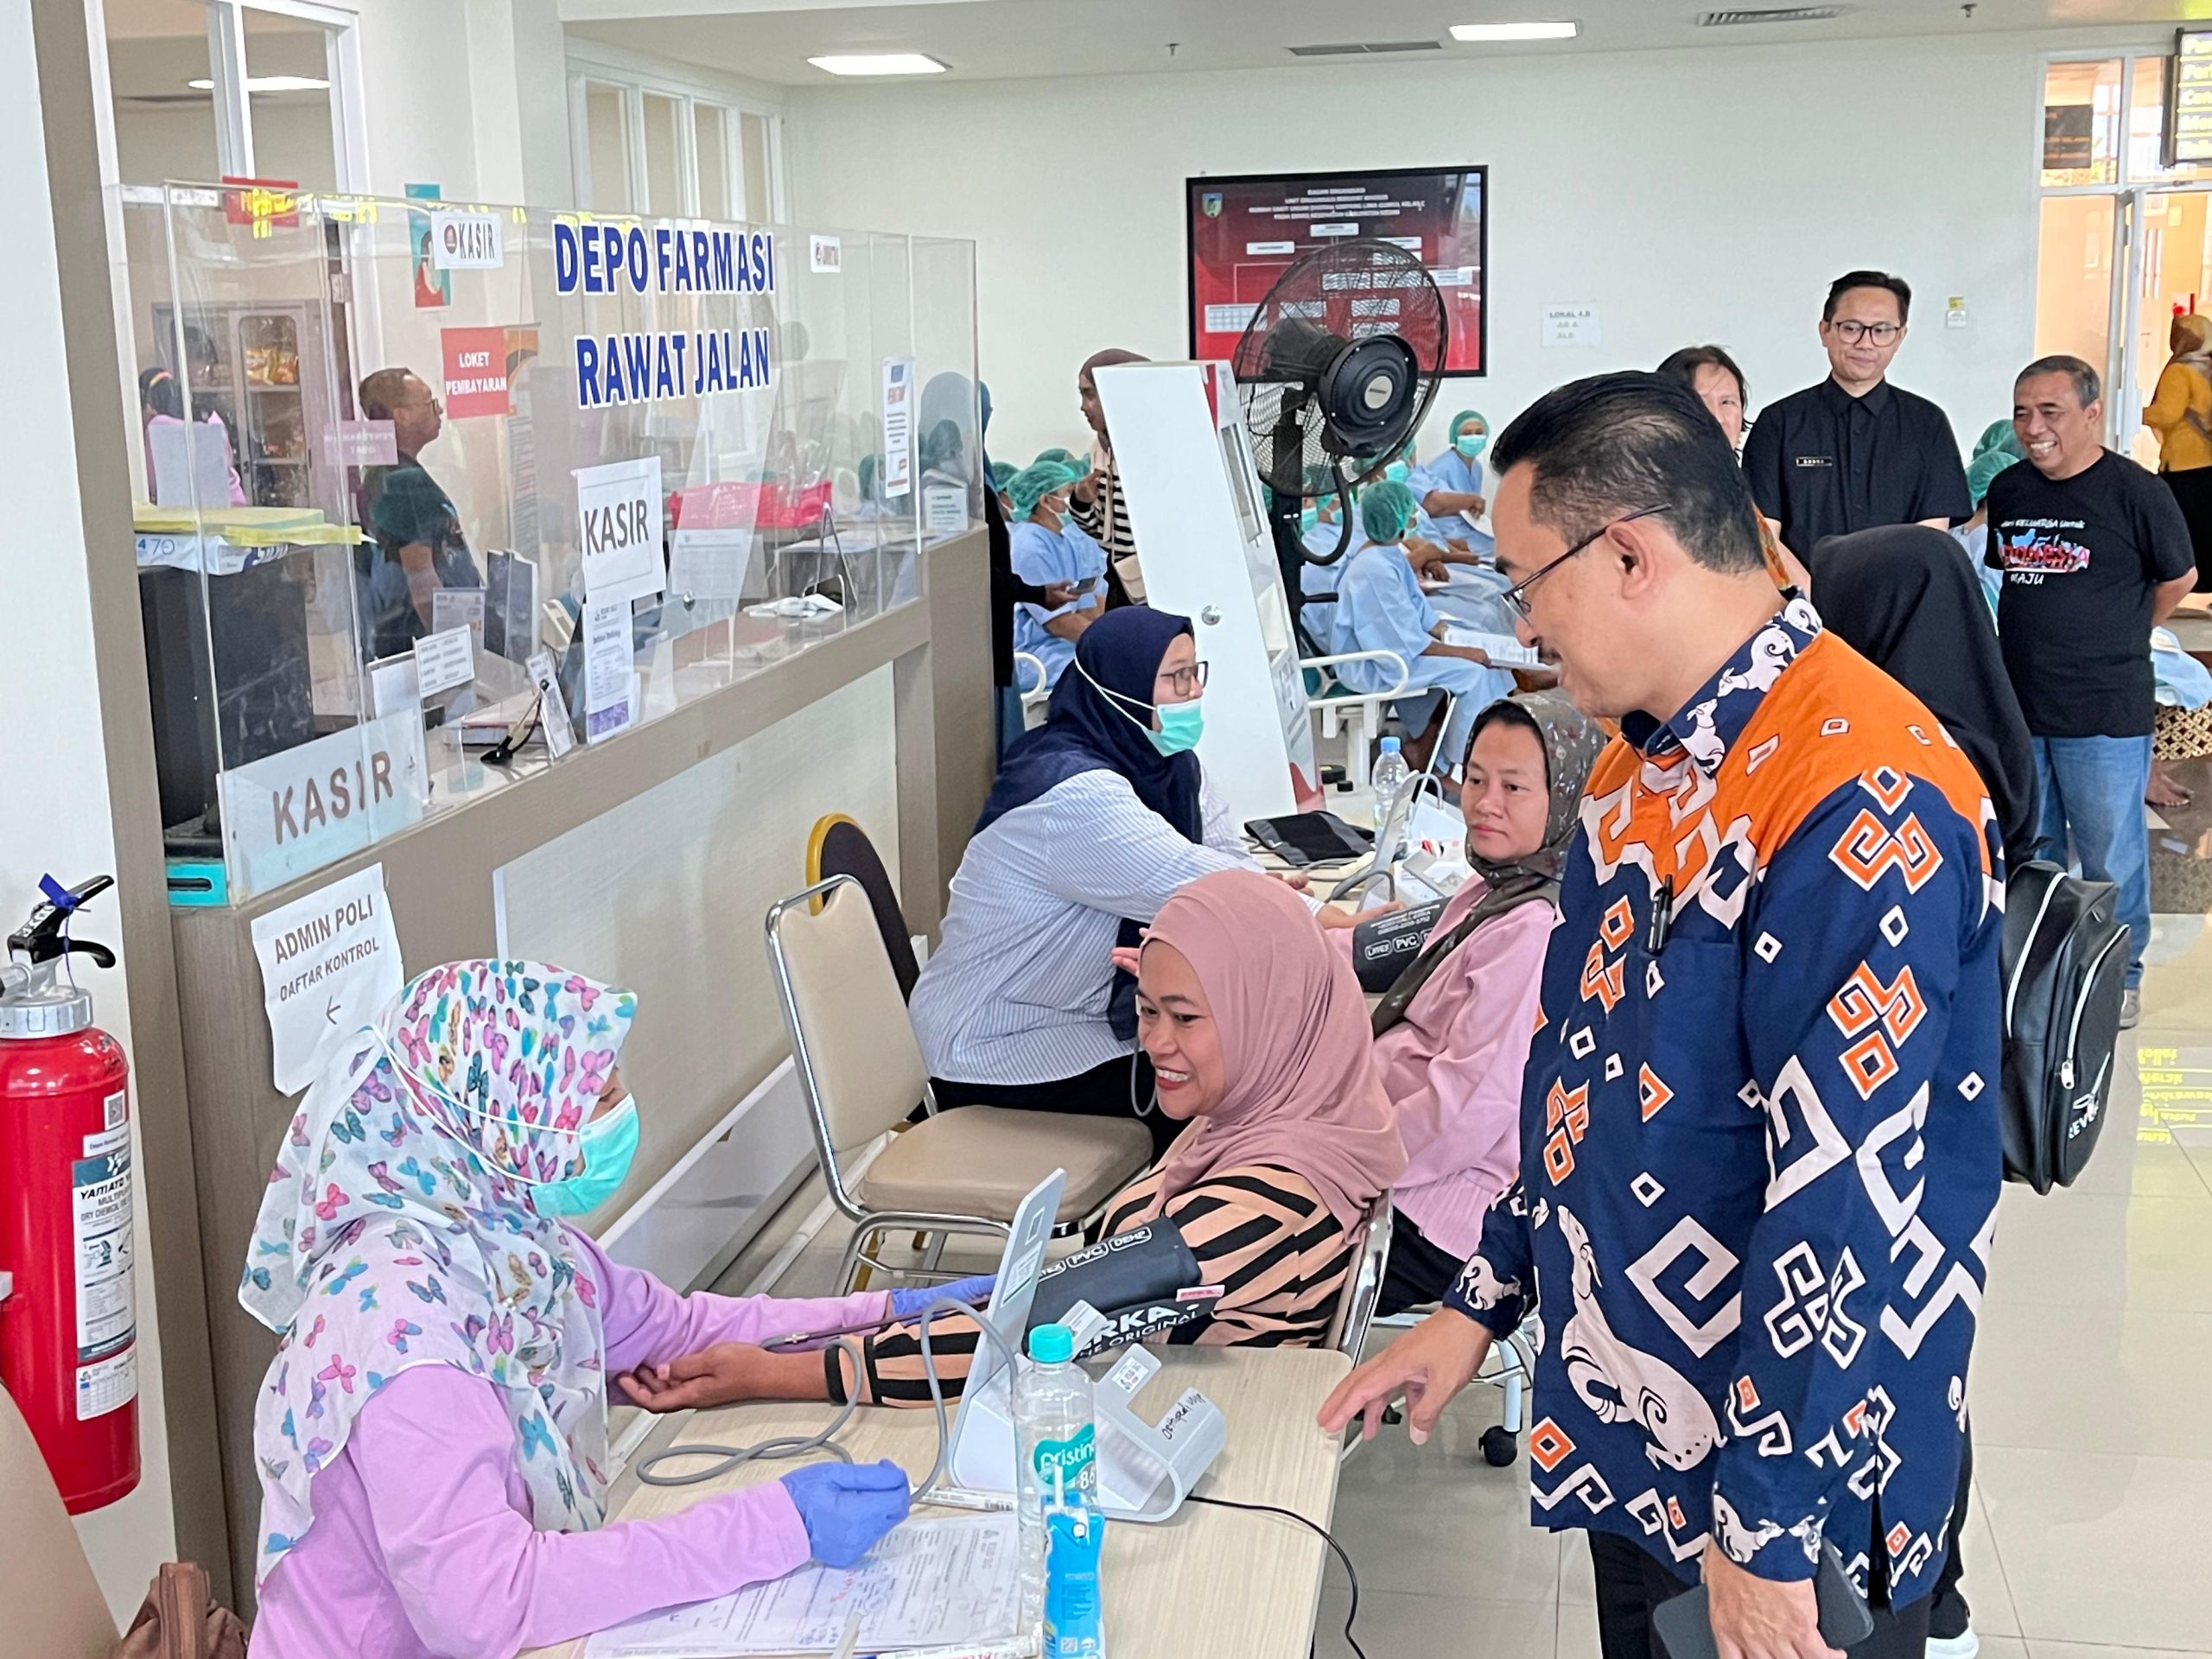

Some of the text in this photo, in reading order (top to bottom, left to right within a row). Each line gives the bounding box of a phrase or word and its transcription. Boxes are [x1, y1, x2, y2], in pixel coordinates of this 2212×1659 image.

[458, 222, 495, 259] KASIR
[553, 222, 775, 294] DEPO FARMASI
[459, 352, 490, 368] LOKET
[575, 329, 770, 407] RAWAT JALAN
[445, 376, 507, 396] PEMBAYARAN
[583, 499, 650, 557] KASIR
[273, 750, 394, 845] KASIR
[275, 893, 373, 964] ADMIN POLI
[1395, 936, 1417, 950] PVC
[279, 937, 380, 1002] DAFTAR KONTROL
[80, 1177, 124, 1199] YAMATO
[1072, 1245, 1103, 1264] PVC
[1114, 1230, 1146, 1247] DEHP
[1109, 1310, 1198, 1347] ORIGINAL
[1040, 1442, 1095, 1471] Pristin
